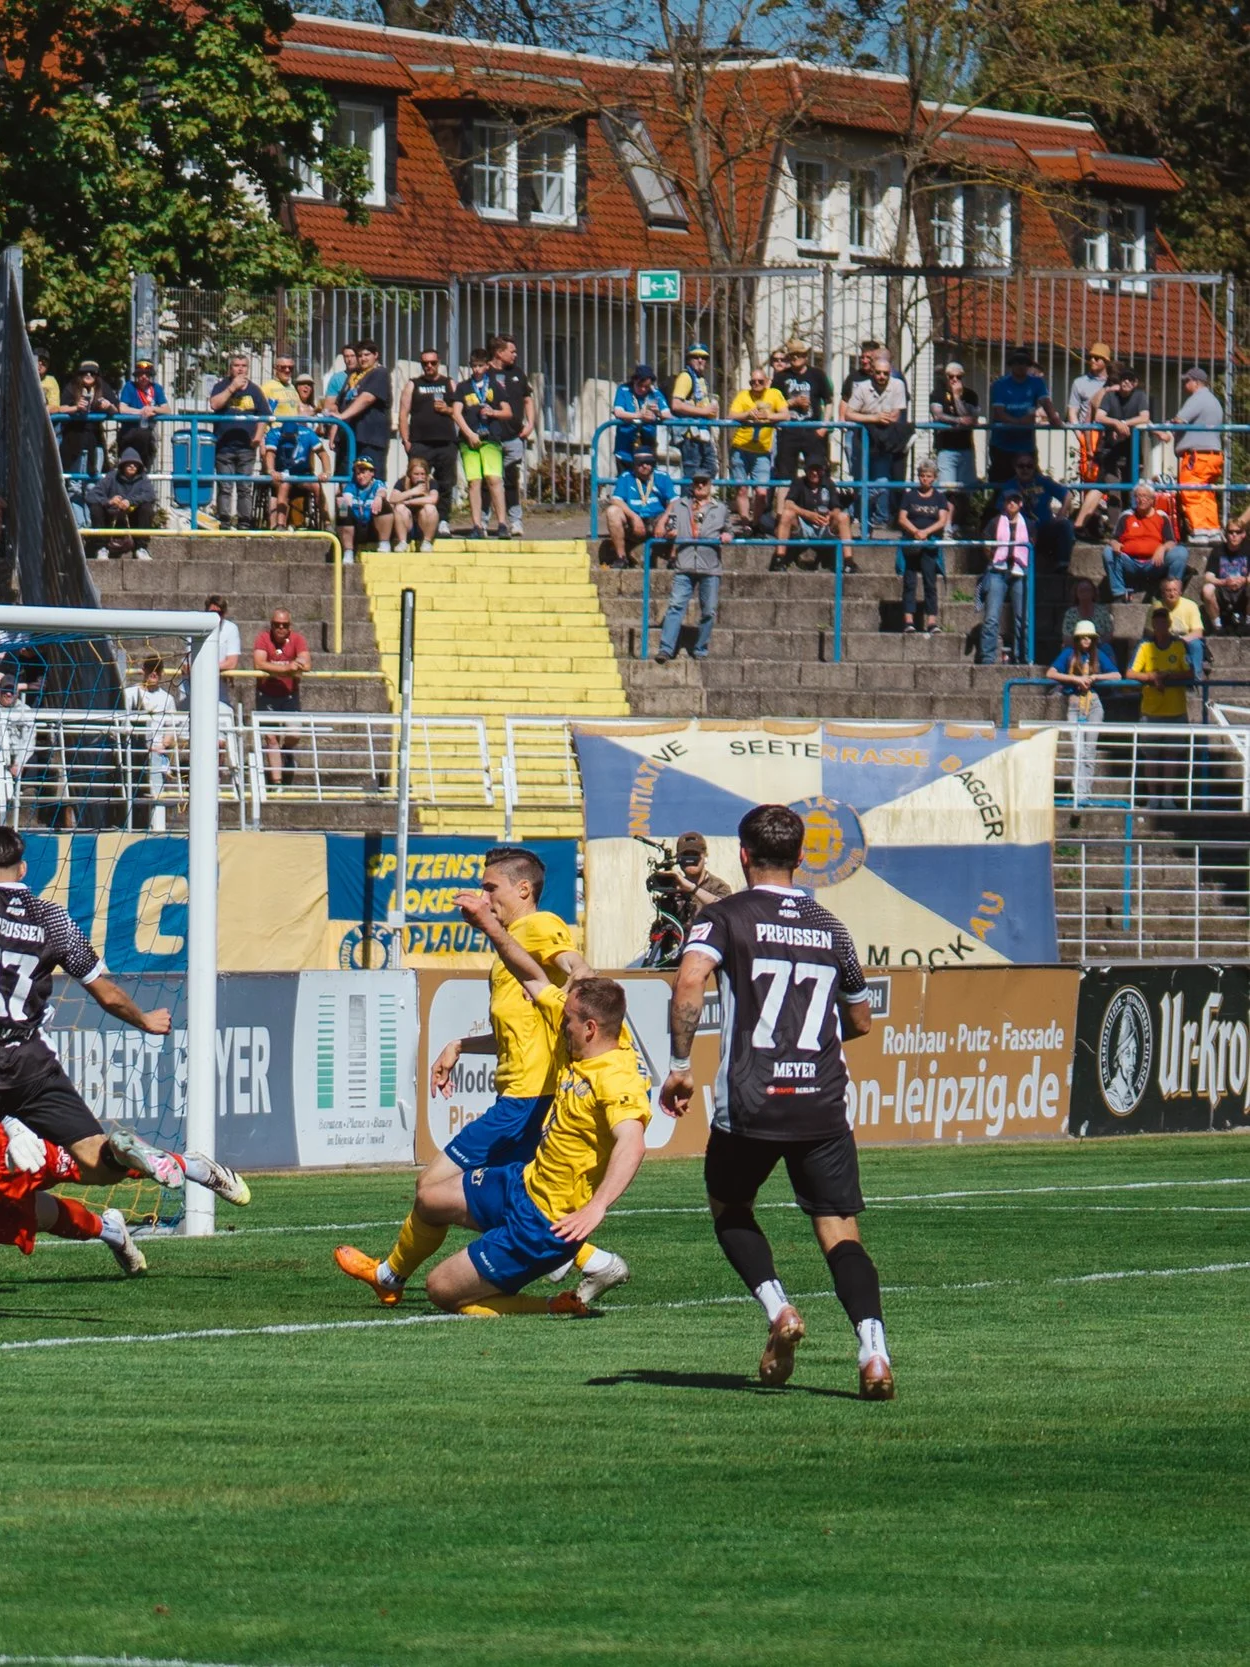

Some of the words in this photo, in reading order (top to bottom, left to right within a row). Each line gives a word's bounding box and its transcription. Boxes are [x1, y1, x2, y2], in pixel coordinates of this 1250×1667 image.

[729, 739, 930, 768] SEETERRASSE
[755, 922, 833, 949] PREUSSEN
[867, 891, 1005, 966] MOCKAU
[751, 957, 837, 1051] 77
[882, 1023, 947, 1055] Rohbau
[957, 1023, 991, 1052] Putz
[1001, 1019, 1064, 1050] Fassade
[772, 1062, 817, 1078] MEYER
